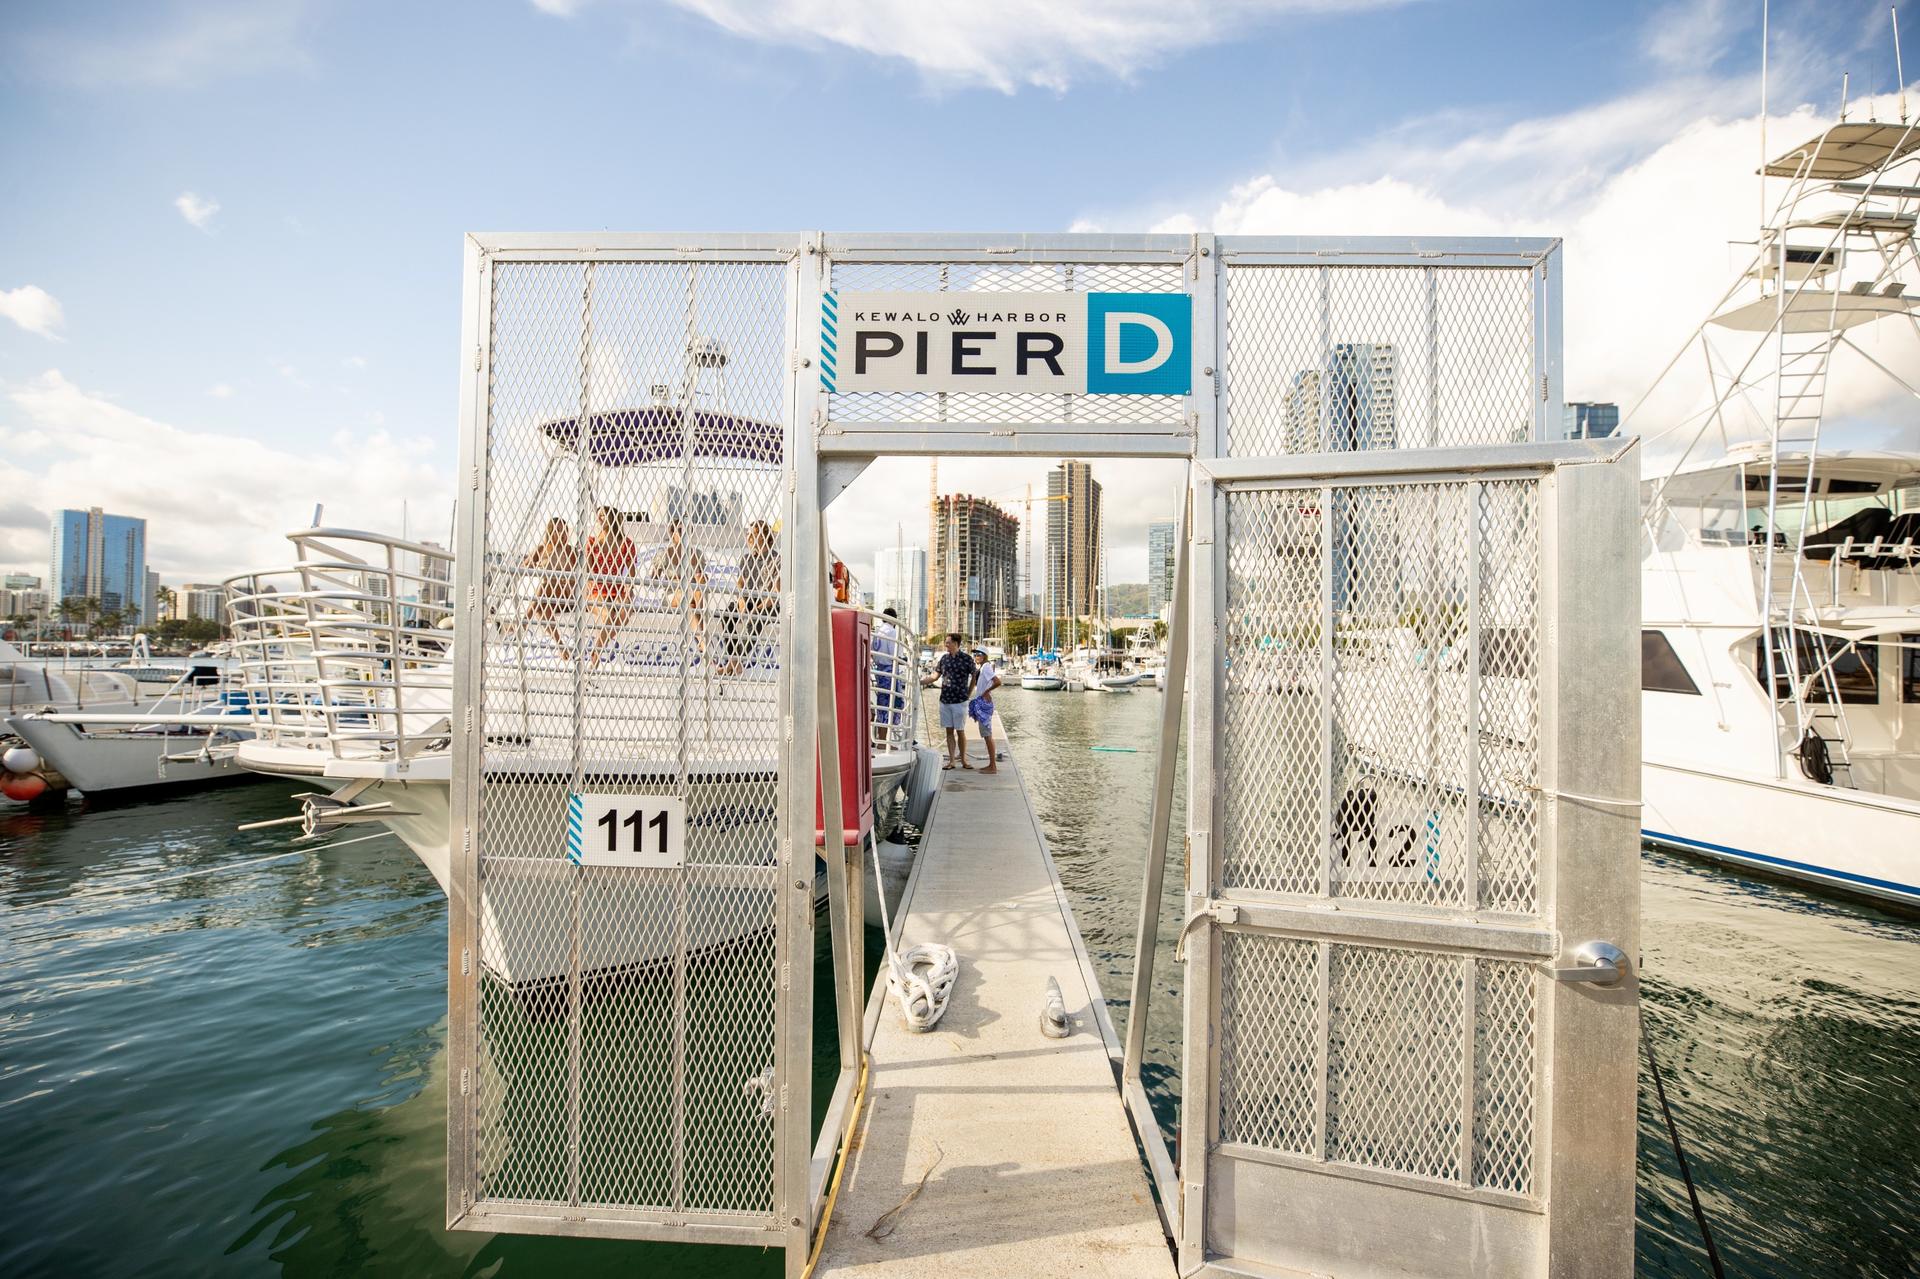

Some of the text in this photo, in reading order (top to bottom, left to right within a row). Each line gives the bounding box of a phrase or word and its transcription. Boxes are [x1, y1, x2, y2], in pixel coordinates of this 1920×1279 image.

[855, 312, 1066, 323] KEWALO HARBOR
[855, 311, 1174, 376] PIER D
[598, 809, 668, 853] 111
